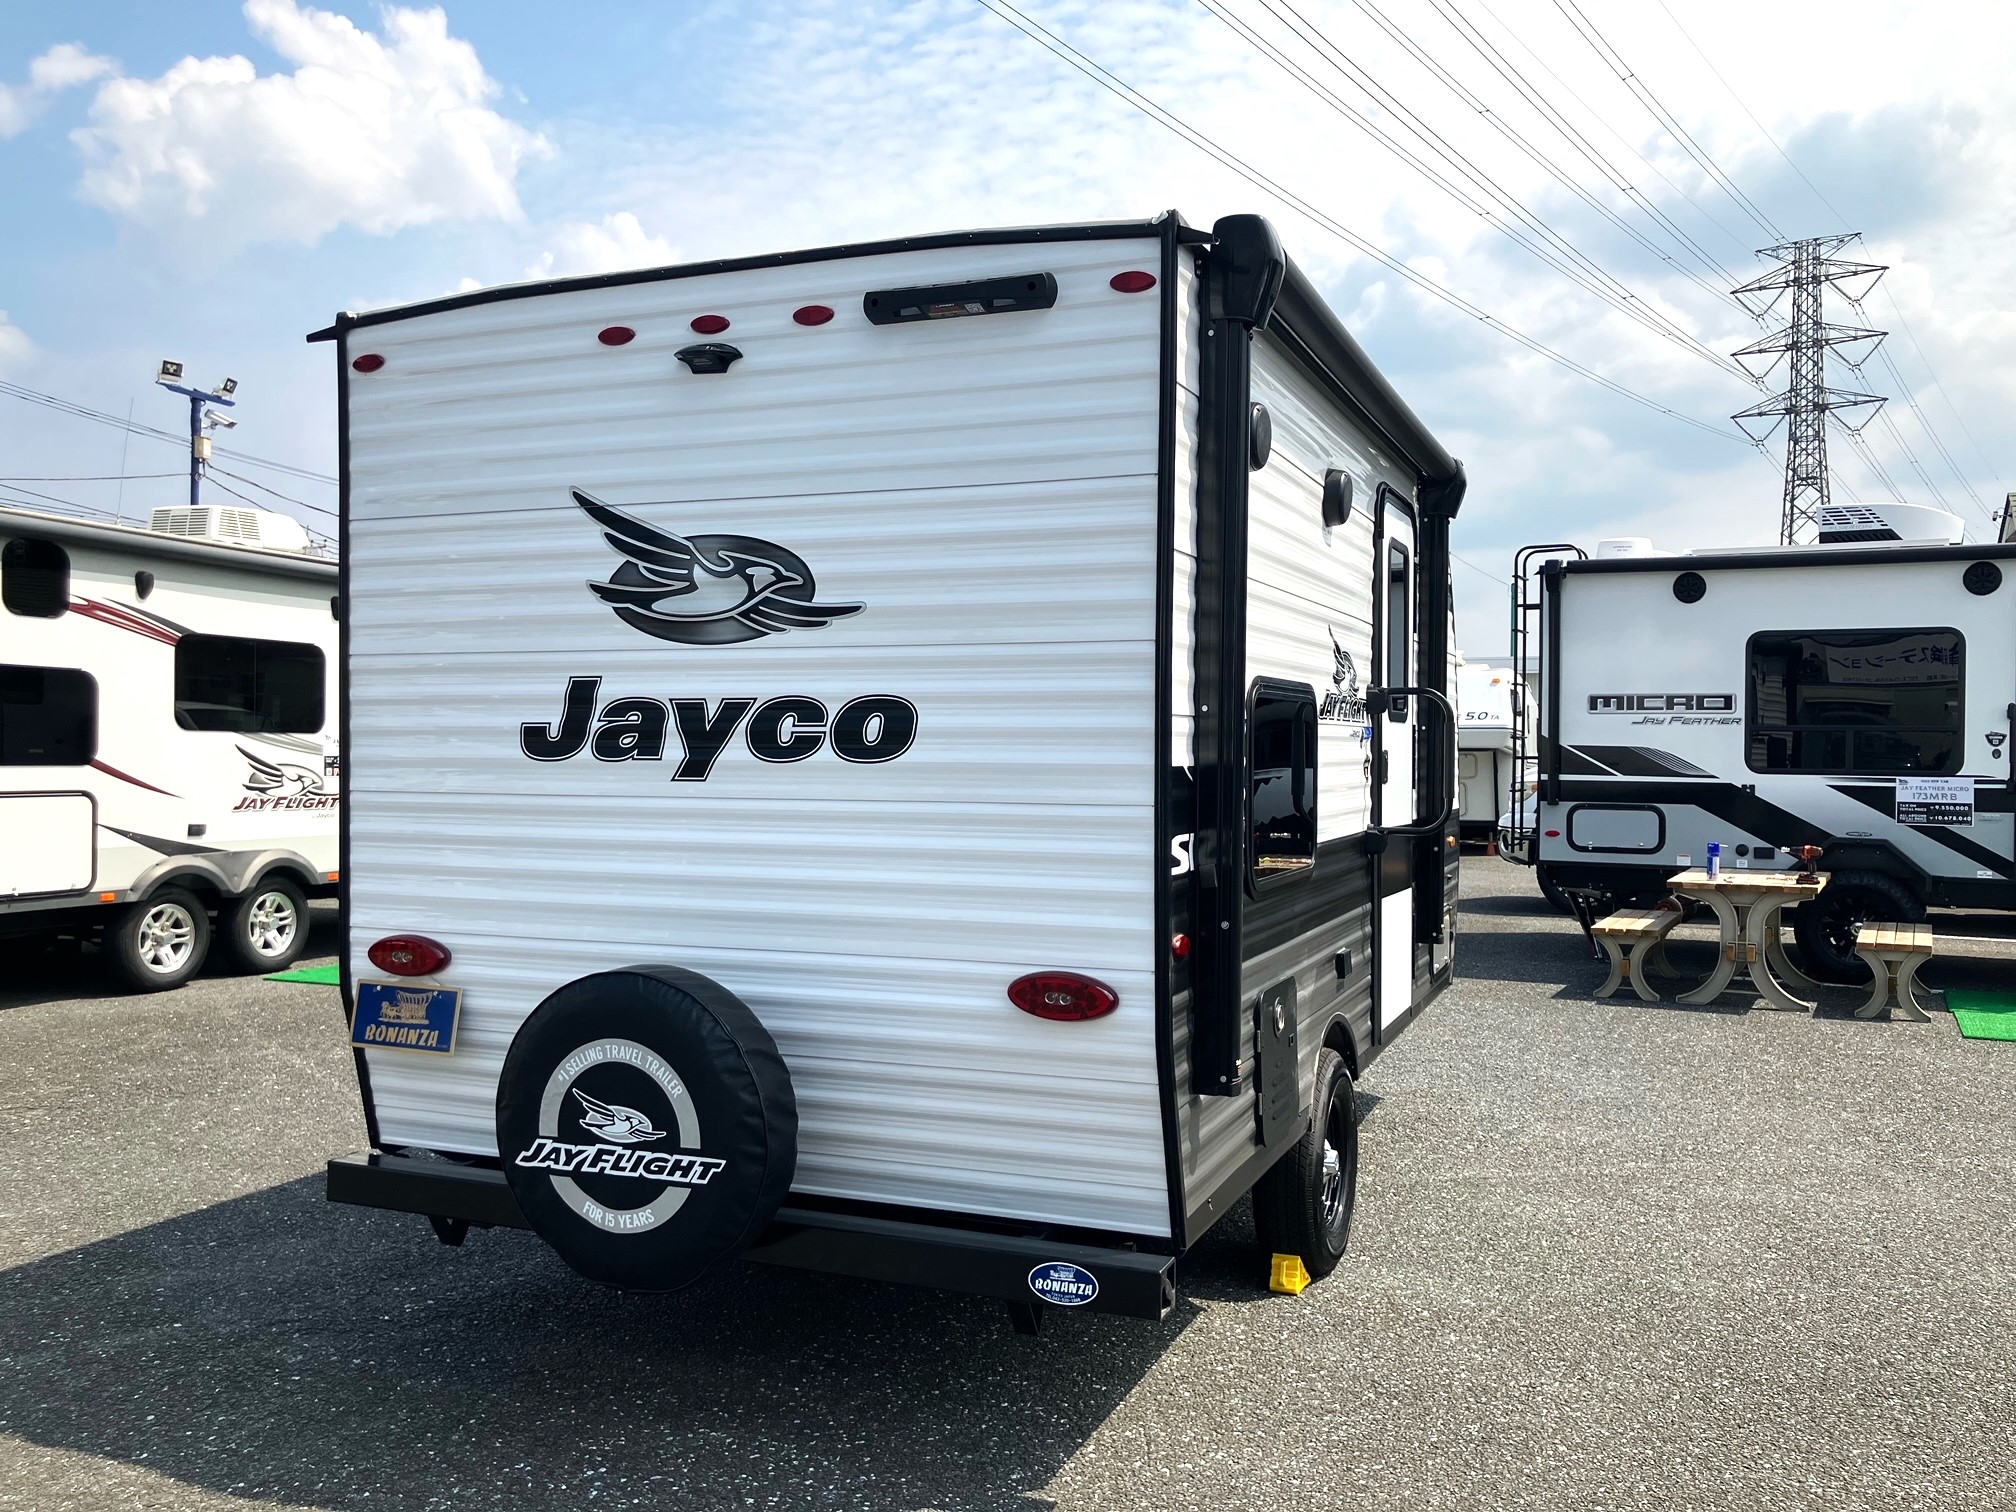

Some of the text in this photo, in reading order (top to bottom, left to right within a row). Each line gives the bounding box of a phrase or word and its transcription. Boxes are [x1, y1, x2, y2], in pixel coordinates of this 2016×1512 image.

[1588, 694, 1735, 713] MICRO
[1464, 711, 1489, 721] 5.0
[1631, 716, 1742, 726] JAY FEATHER
[519, 676, 919, 782] Jayco
[1912, 792, 1958, 800] 173MRB
[364, 1024, 440, 1047] BONANZA
[557, 1044, 683, 1098] #1 SELLING TRAVEL TRAILER
[582, 1200, 655, 1229] FOR 15 YEARS
[1035, 1278, 1093, 1296] BONANZA
